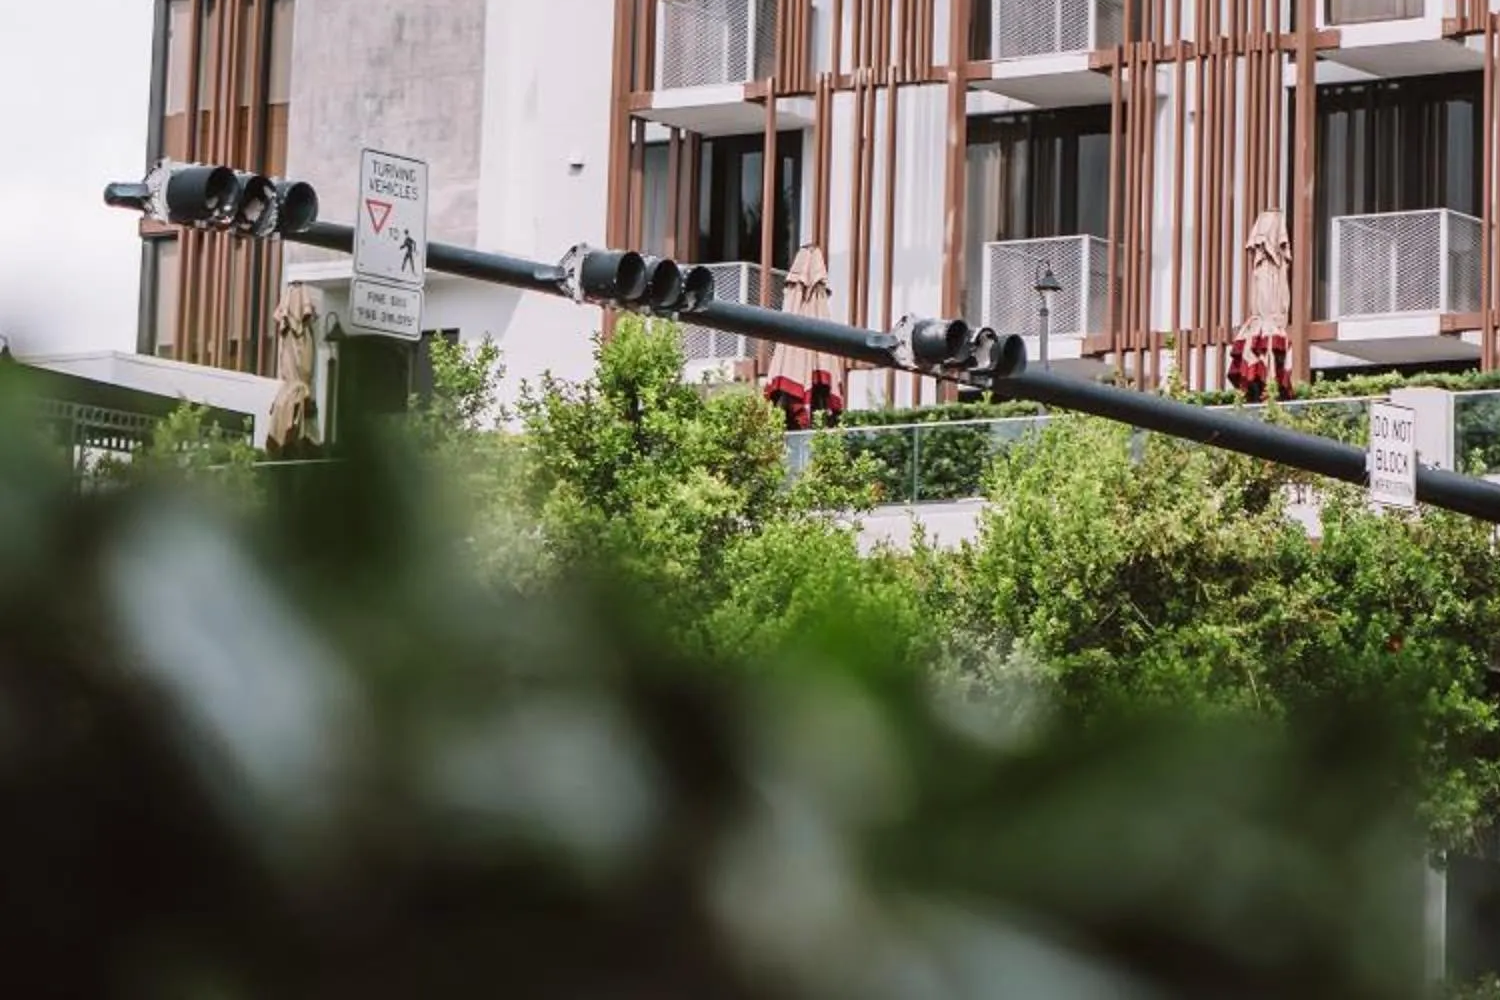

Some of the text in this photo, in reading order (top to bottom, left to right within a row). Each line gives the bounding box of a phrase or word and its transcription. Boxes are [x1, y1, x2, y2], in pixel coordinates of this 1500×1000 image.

[371, 159, 416, 183] TURNING
[369, 179, 418, 201] VEHICLES
[388, 227, 399, 241] TO
[1374, 415, 1412, 443] DO NOT
[1375, 449, 1408, 475] BLOCK
